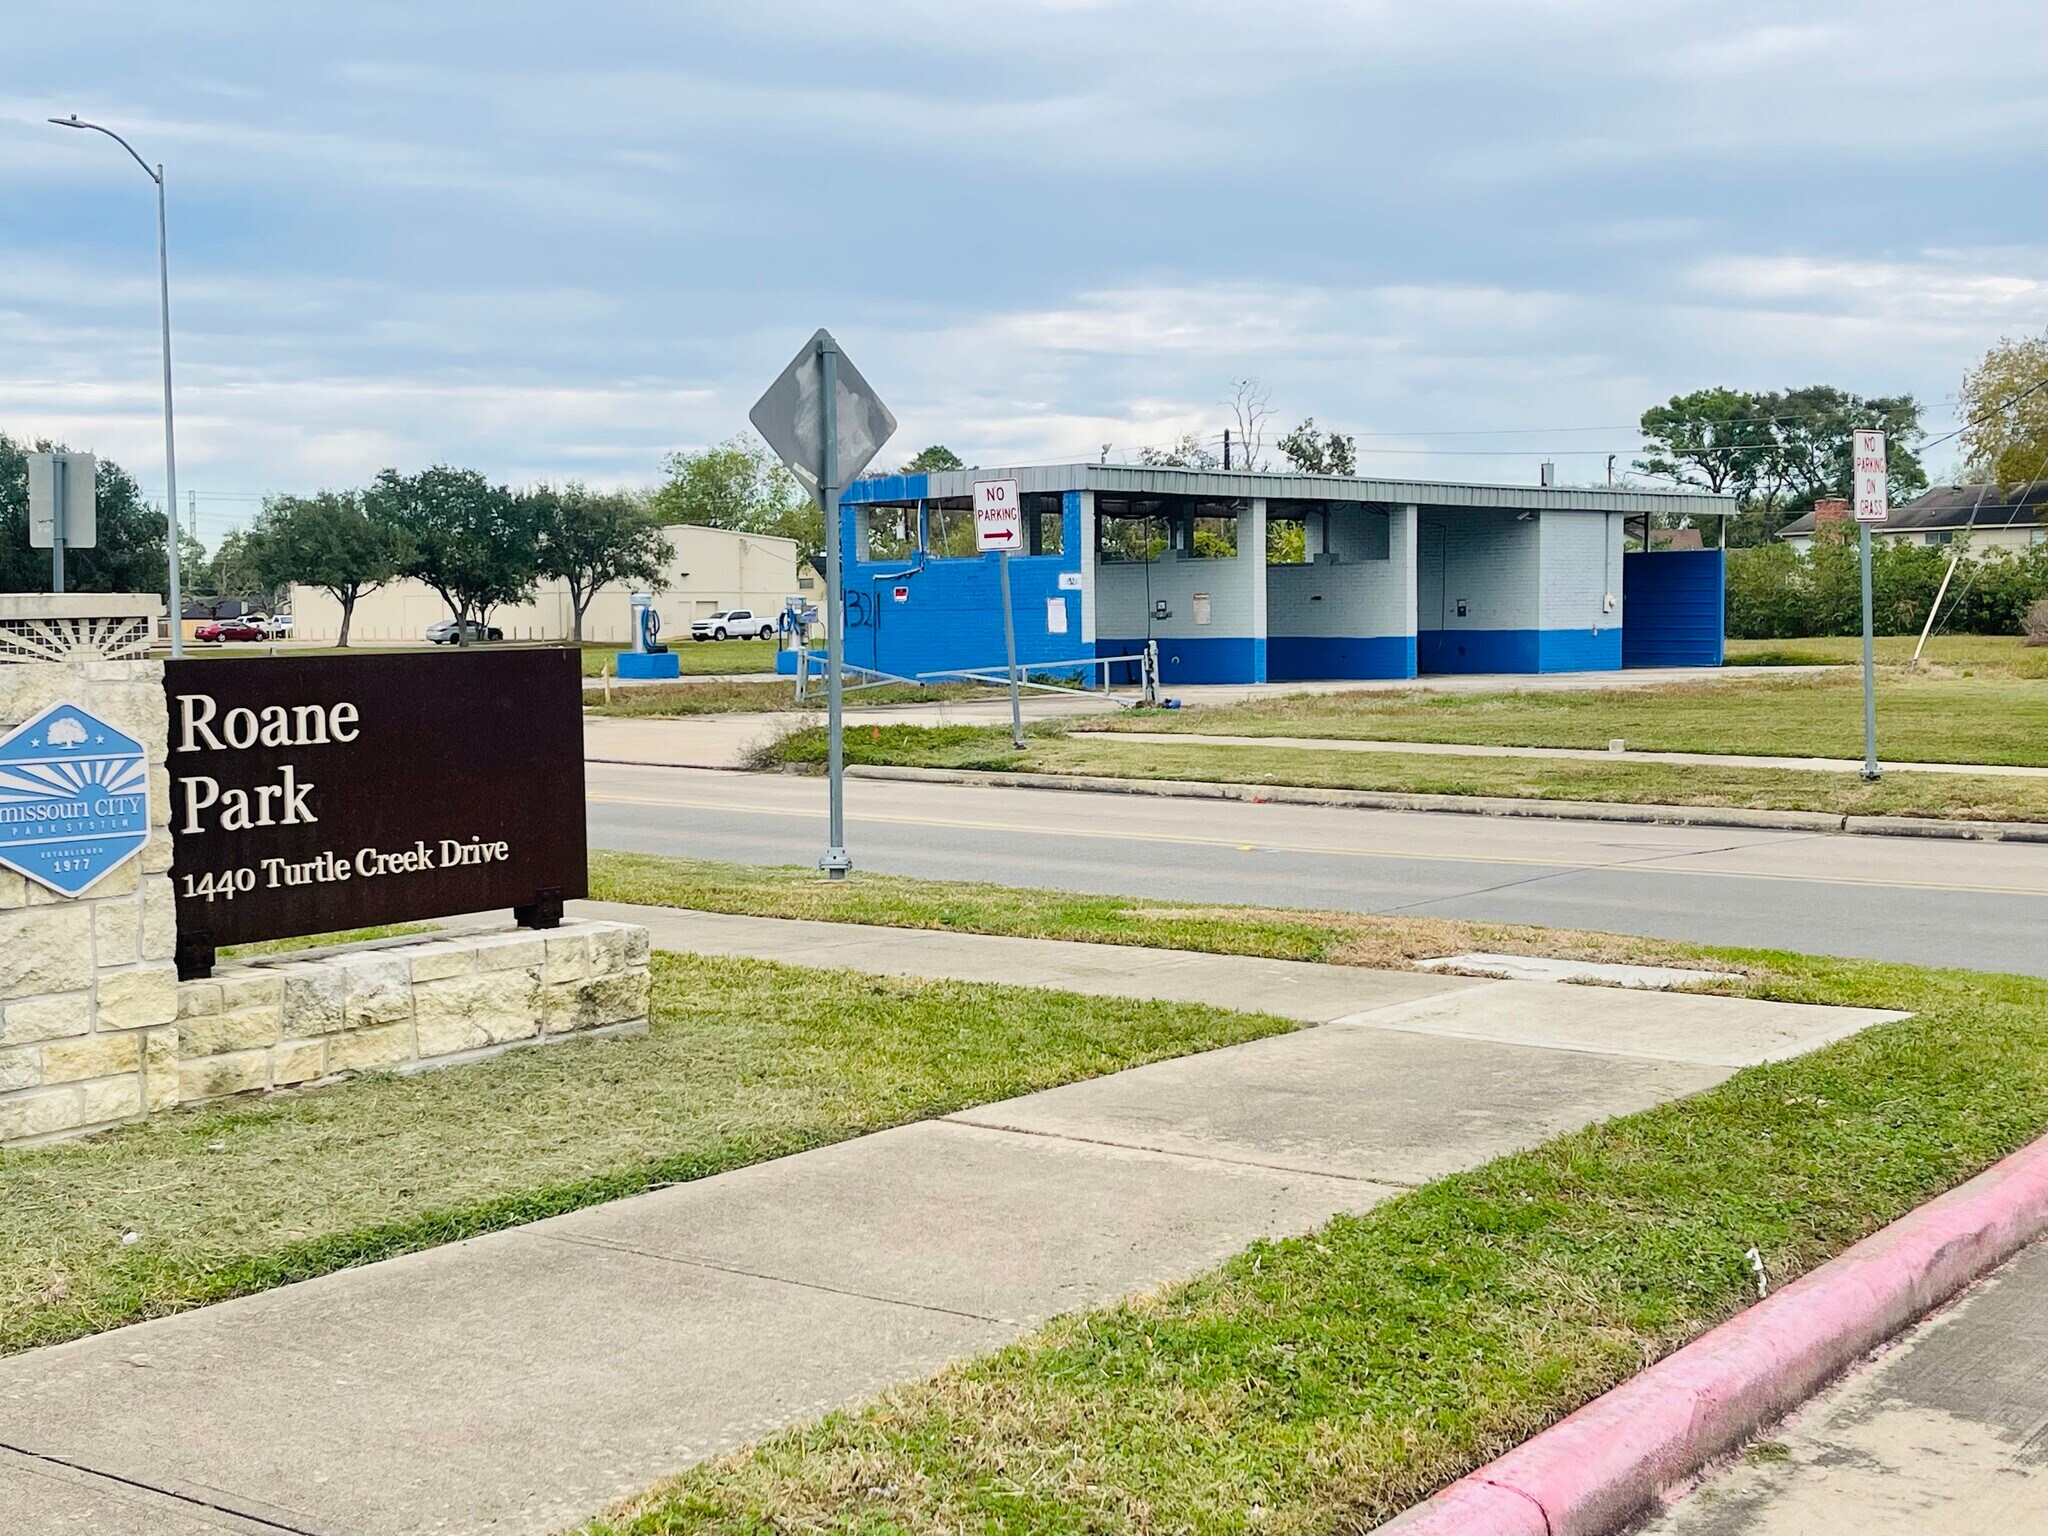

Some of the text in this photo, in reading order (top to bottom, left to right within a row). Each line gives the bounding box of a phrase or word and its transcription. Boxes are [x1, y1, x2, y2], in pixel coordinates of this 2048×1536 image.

[1864, 436, 1876, 452] NO
[1857, 457, 1884, 473] PARKING
[986, 487, 1005, 501] NO
[1866, 478, 1876, 494] ON
[977, 508, 1017, 521] PARKING
[1861, 500, 1883, 515] GRASS
[175, 694, 360, 753] Roane
[94, 796, 141, 817] CITY
[177, 764, 319, 835] Park
[12, 819, 129, 836] PARK SYSTEM
[40, 847, 104, 859] ESTABLISHED
[54, 858, 90, 873] 1977
[181, 835, 510, 903] 1440 Turtle Creek Drive
